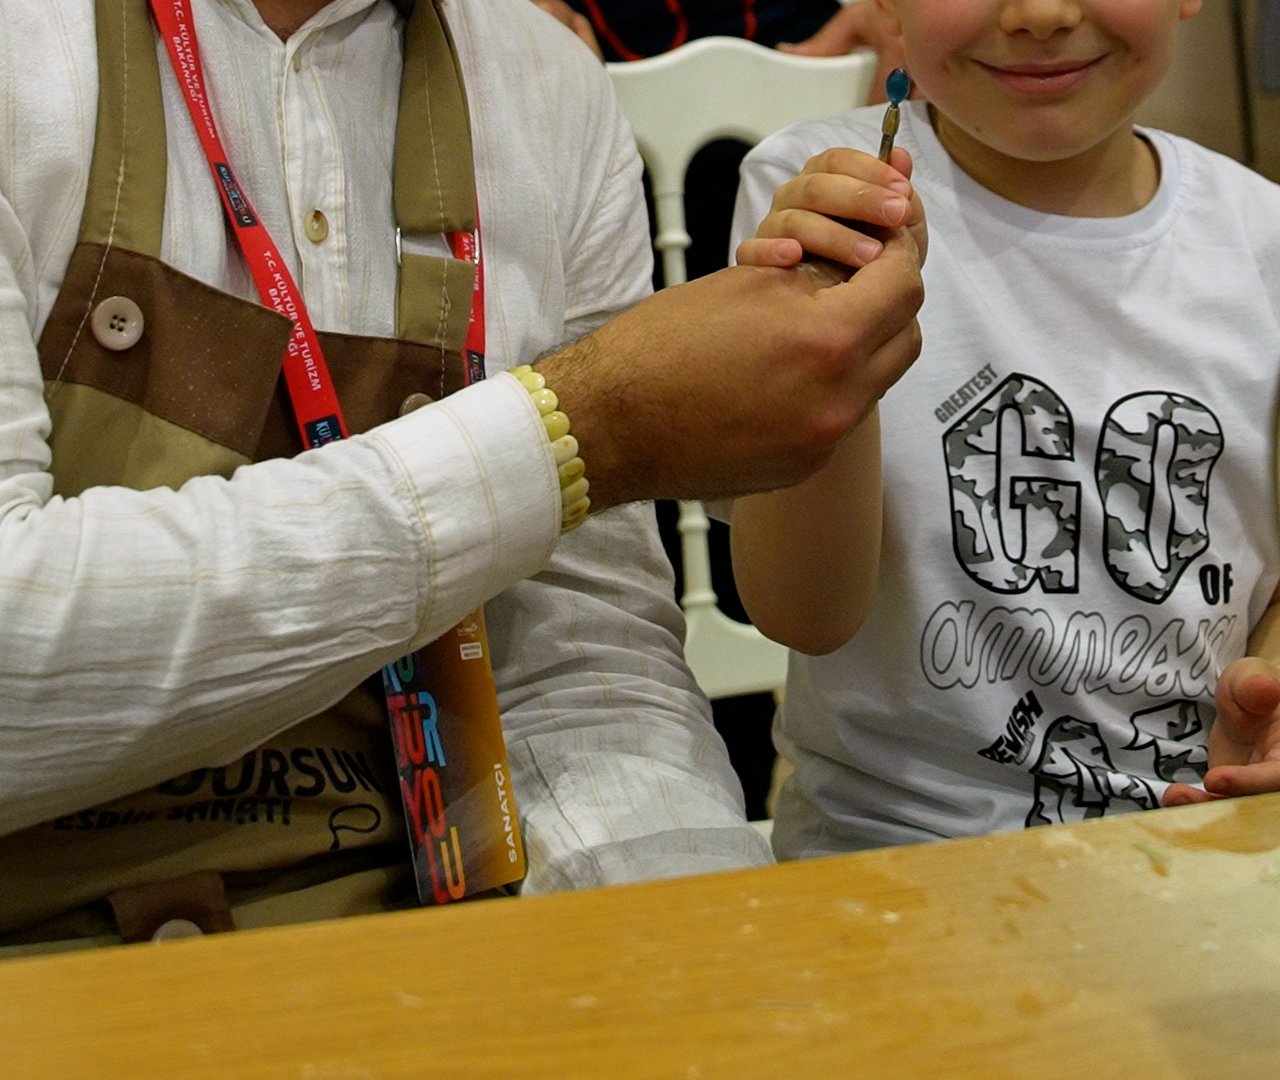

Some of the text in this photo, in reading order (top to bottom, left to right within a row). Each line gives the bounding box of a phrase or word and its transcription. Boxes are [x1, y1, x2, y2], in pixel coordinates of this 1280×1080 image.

[263, 250, 322, 391] T.C. KÜLTÜR VE TURİZM
[934, 363, 998, 424] GREATEST
[1198, 563, 1234, 606] OF
[494, 763, 518, 863] SANATÇI
